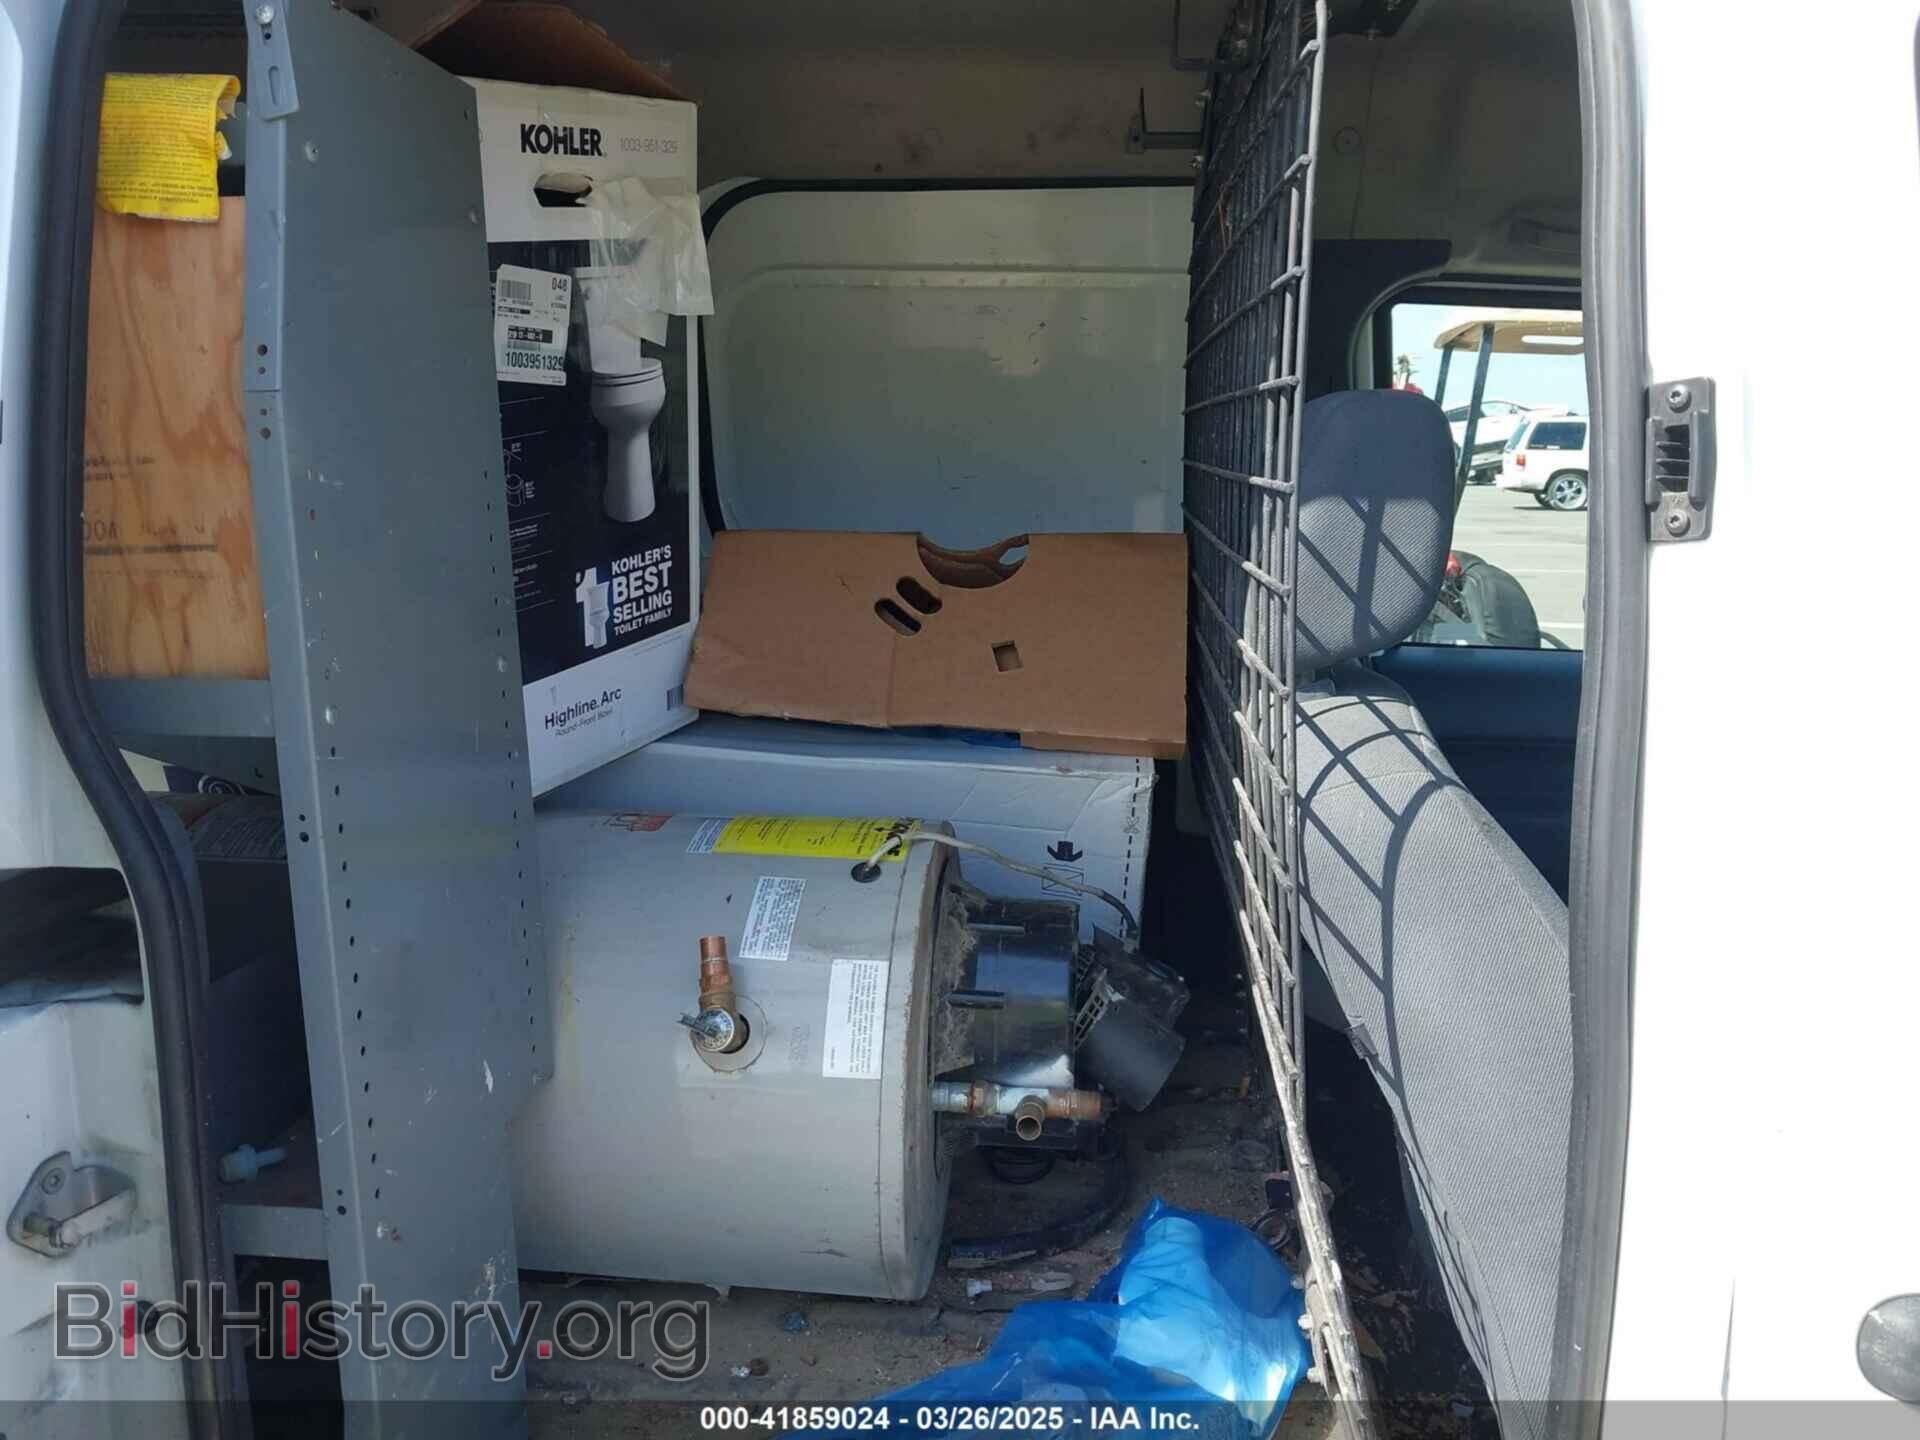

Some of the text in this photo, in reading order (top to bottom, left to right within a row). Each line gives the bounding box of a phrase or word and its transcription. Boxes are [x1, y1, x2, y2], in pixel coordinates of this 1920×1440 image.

[520, 123, 603, 157] KOHLER
[611, 544, 672, 576] KOHLER'S
[612, 560, 673, 605] BEST
[613, 589, 673, 624] SELLING
[614, 607, 672, 636] TOILET FAMILY
[600, 688, 622, 706] Arc
